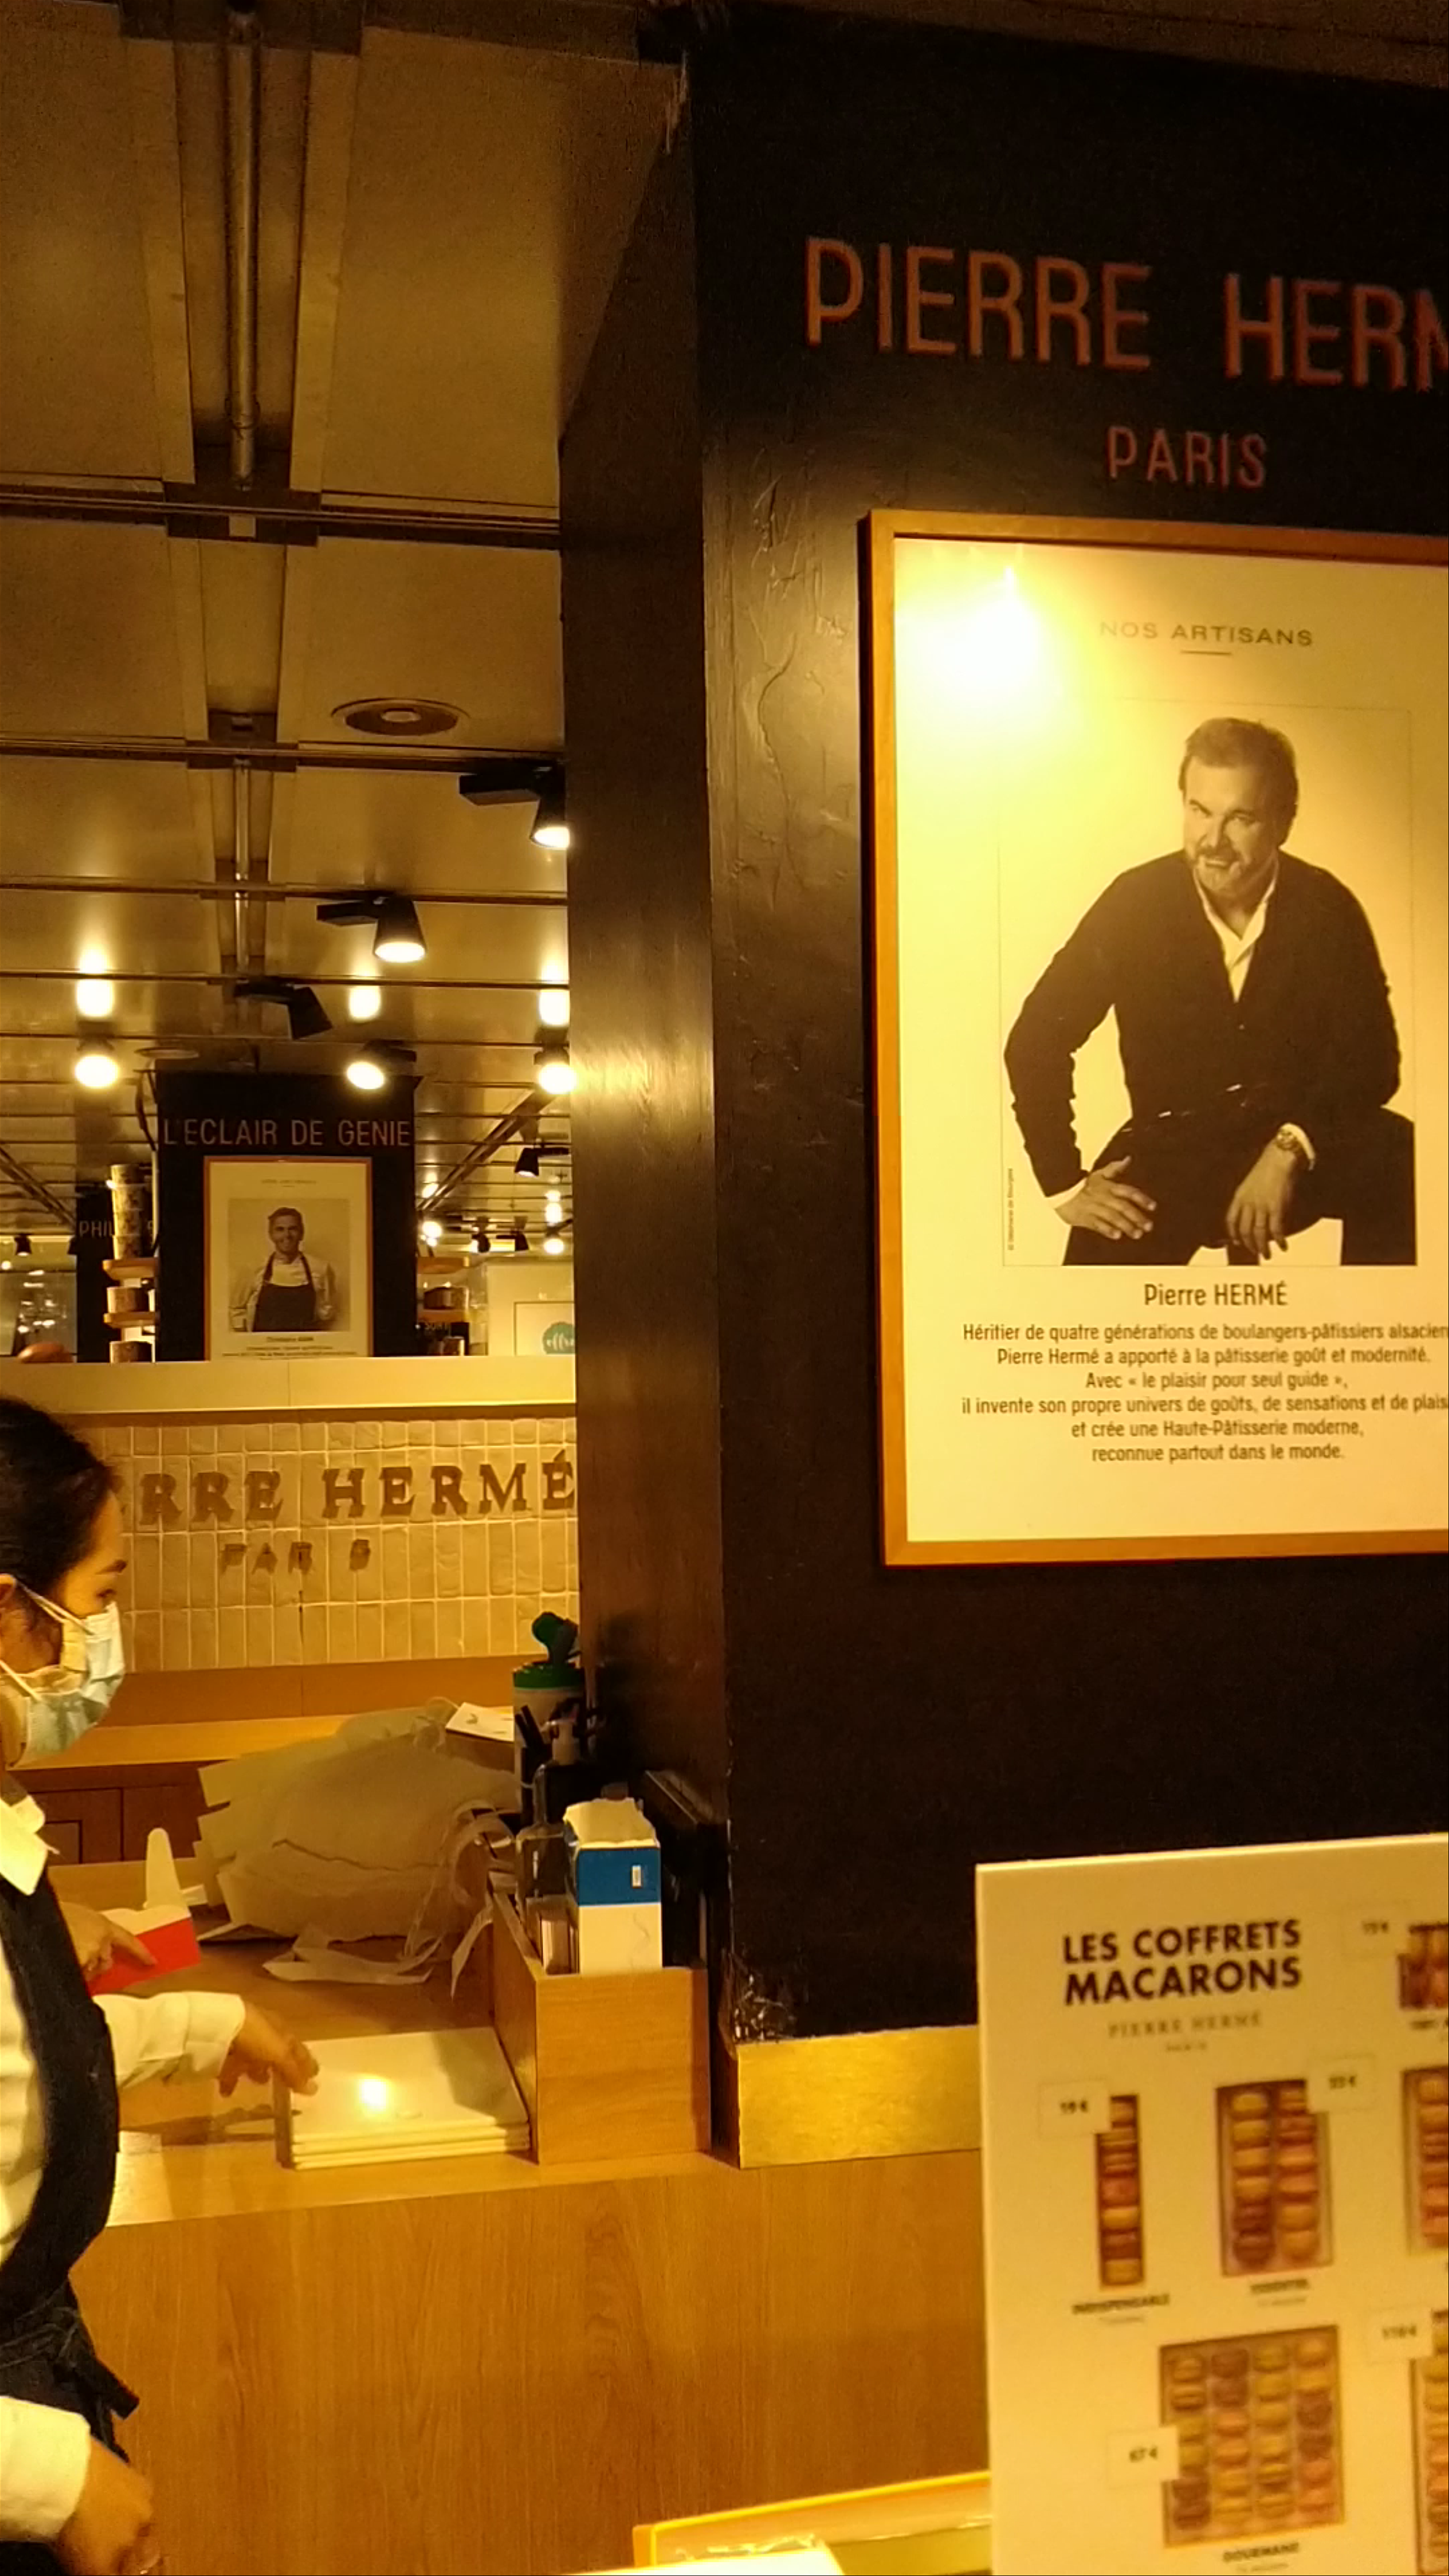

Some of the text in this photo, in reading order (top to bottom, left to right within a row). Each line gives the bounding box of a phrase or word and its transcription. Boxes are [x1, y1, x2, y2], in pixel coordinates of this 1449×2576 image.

[805, 236, 1151, 371] PIERRE
[1106, 425, 1268, 491] PARIS
[1099, 621, 1313, 647] NOS ARTISANS
[164, 1118, 411, 1147] L'ECLAIR DE GENIE
[1144, 1280, 1287, 1306] Pierre HERMÉ
[963, 1323, 1020, 1340] Héritier
[1025, 1324, 1044, 1340] de
[1049, 1324, 1099, 1343] quatre
[1104, 1323, 1195, 1343] générations
[1200, 1324, 1218, 1339] de
[1223, 1323, 1384, 1343] boulangers-pâtissiers
[997, 1346, 1431, 1367] Pierre Hermé a apporté à la pâtisserie goût et modernité.
[1086, 1372, 1122, 1388] Avec
[1142, 1372, 1156, 1388] le
[1161, 1372, 1206, 1392] plaisir
[1212, 1374, 1246, 1390] pour
[1251, 1372, 1283, 1387] seul
[1287, 1372, 1329, 1391] guide
[962, 1398, 971, 1414] il
[976, 1398, 1033, 1414] invente
[1038, 1401, 1066, 1413] son
[1072, 1399, 1121, 1416] propre
[1126, 1397, 1183, 1412] univers
[1188, 1396, 1206, 1412] de
[1211, 1396, 1258, 1415] goûts,
[1263, 1396, 1281, 1411] de
[1286, 1395, 1366, 1411] sensations
[1371, 1395, 1385, 1411] et
[1390, 1395, 1408, 1410] de
[1072, 1419, 1364, 1438] et crée une Haute-Pâtisserie moderne,
[1092, 1444, 1345, 1464] reconnue partout dans le monde.
[321, 1449, 575, 1519] HERMÉ
[1063, 1919, 1301, 1964] LES COFFRETS
[1065, 1956, 1302, 2006] MACARONS
